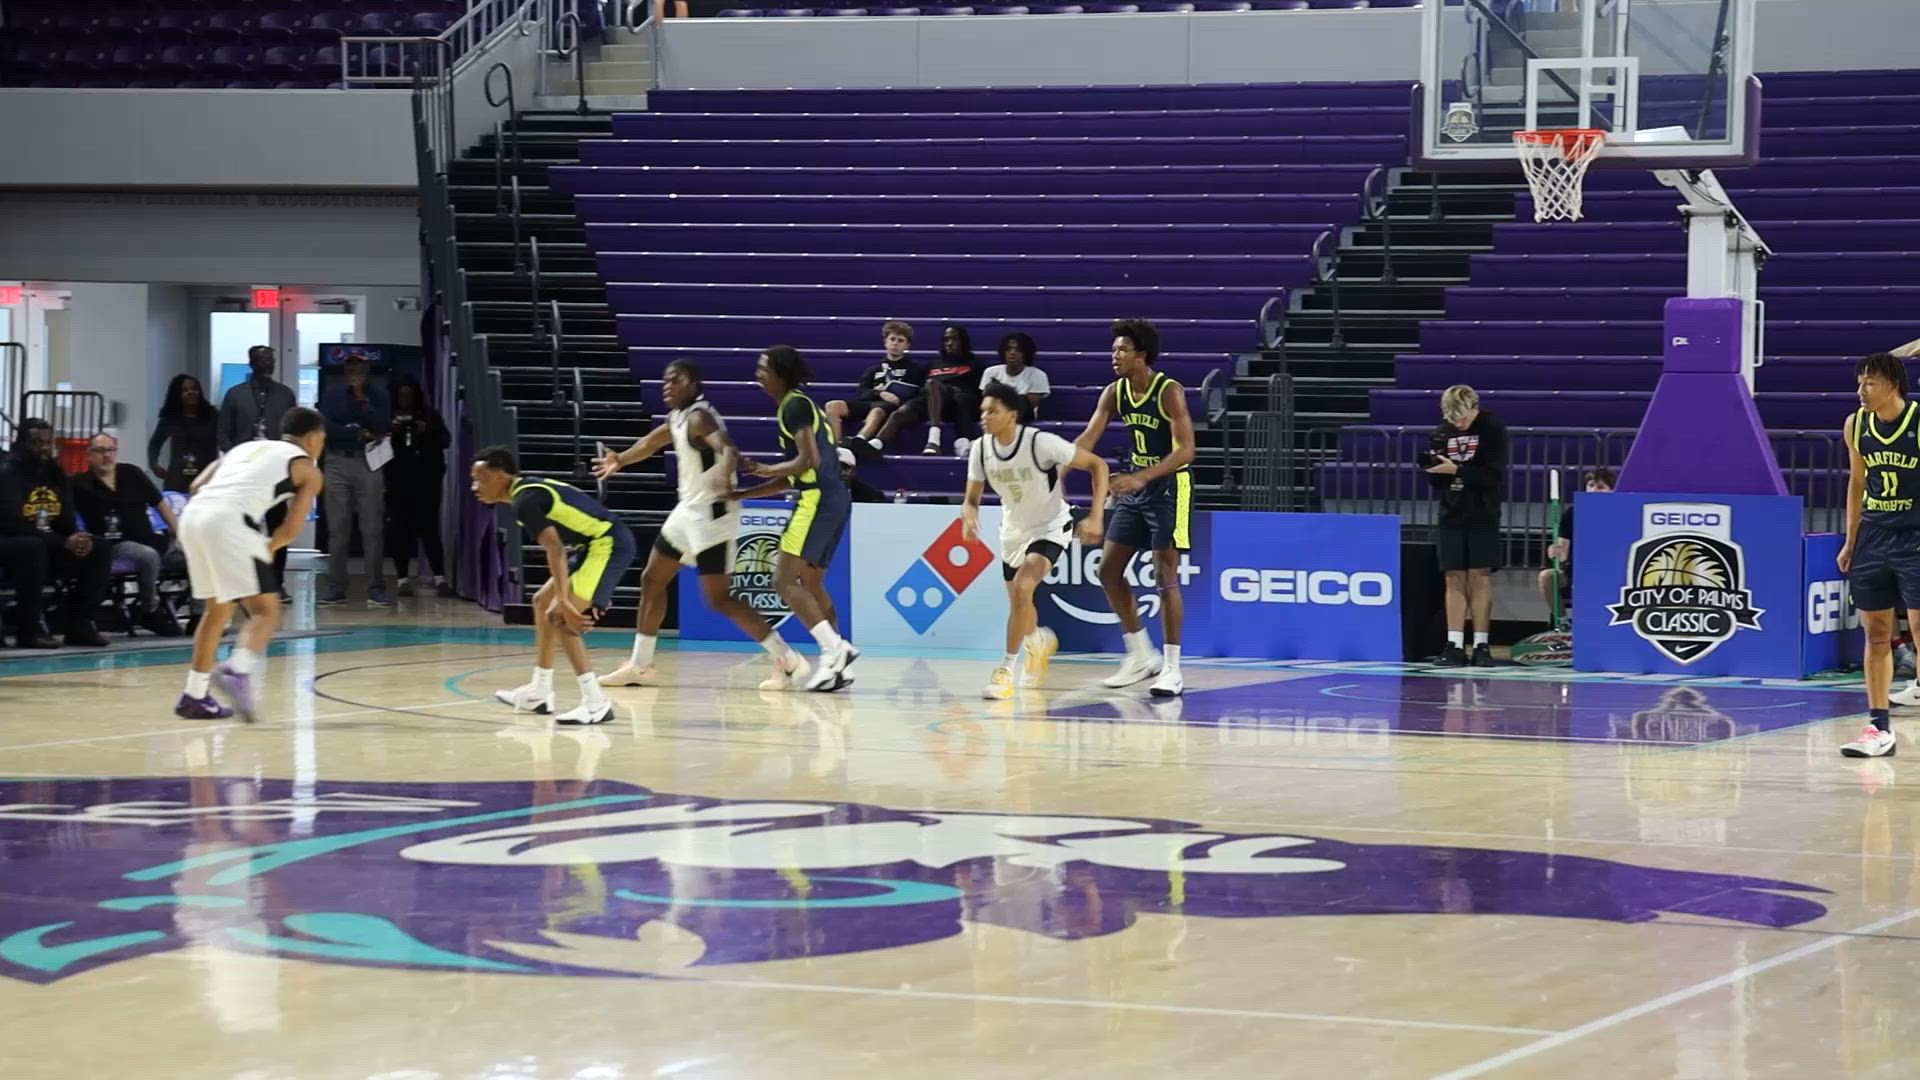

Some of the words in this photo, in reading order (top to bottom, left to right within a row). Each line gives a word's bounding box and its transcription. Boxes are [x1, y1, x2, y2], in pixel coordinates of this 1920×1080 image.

[1134, 430, 1148, 454] 0
[1881, 471, 1899, 497] 11
[740, 516, 787, 526] GEICO
[1651, 512, 1721, 526] GEICO
[753, 573, 771, 587] OF
[1220, 568, 1393, 606] GEICO
[1627, 588, 1666, 607] CITY
[1669, 588, 1694, 604] OF
[1698, 589, 1744, 610] PALMS
[1808, 580, 1866, 634] GEIC
[1646, 612, 1720, 633] CLASSIC
